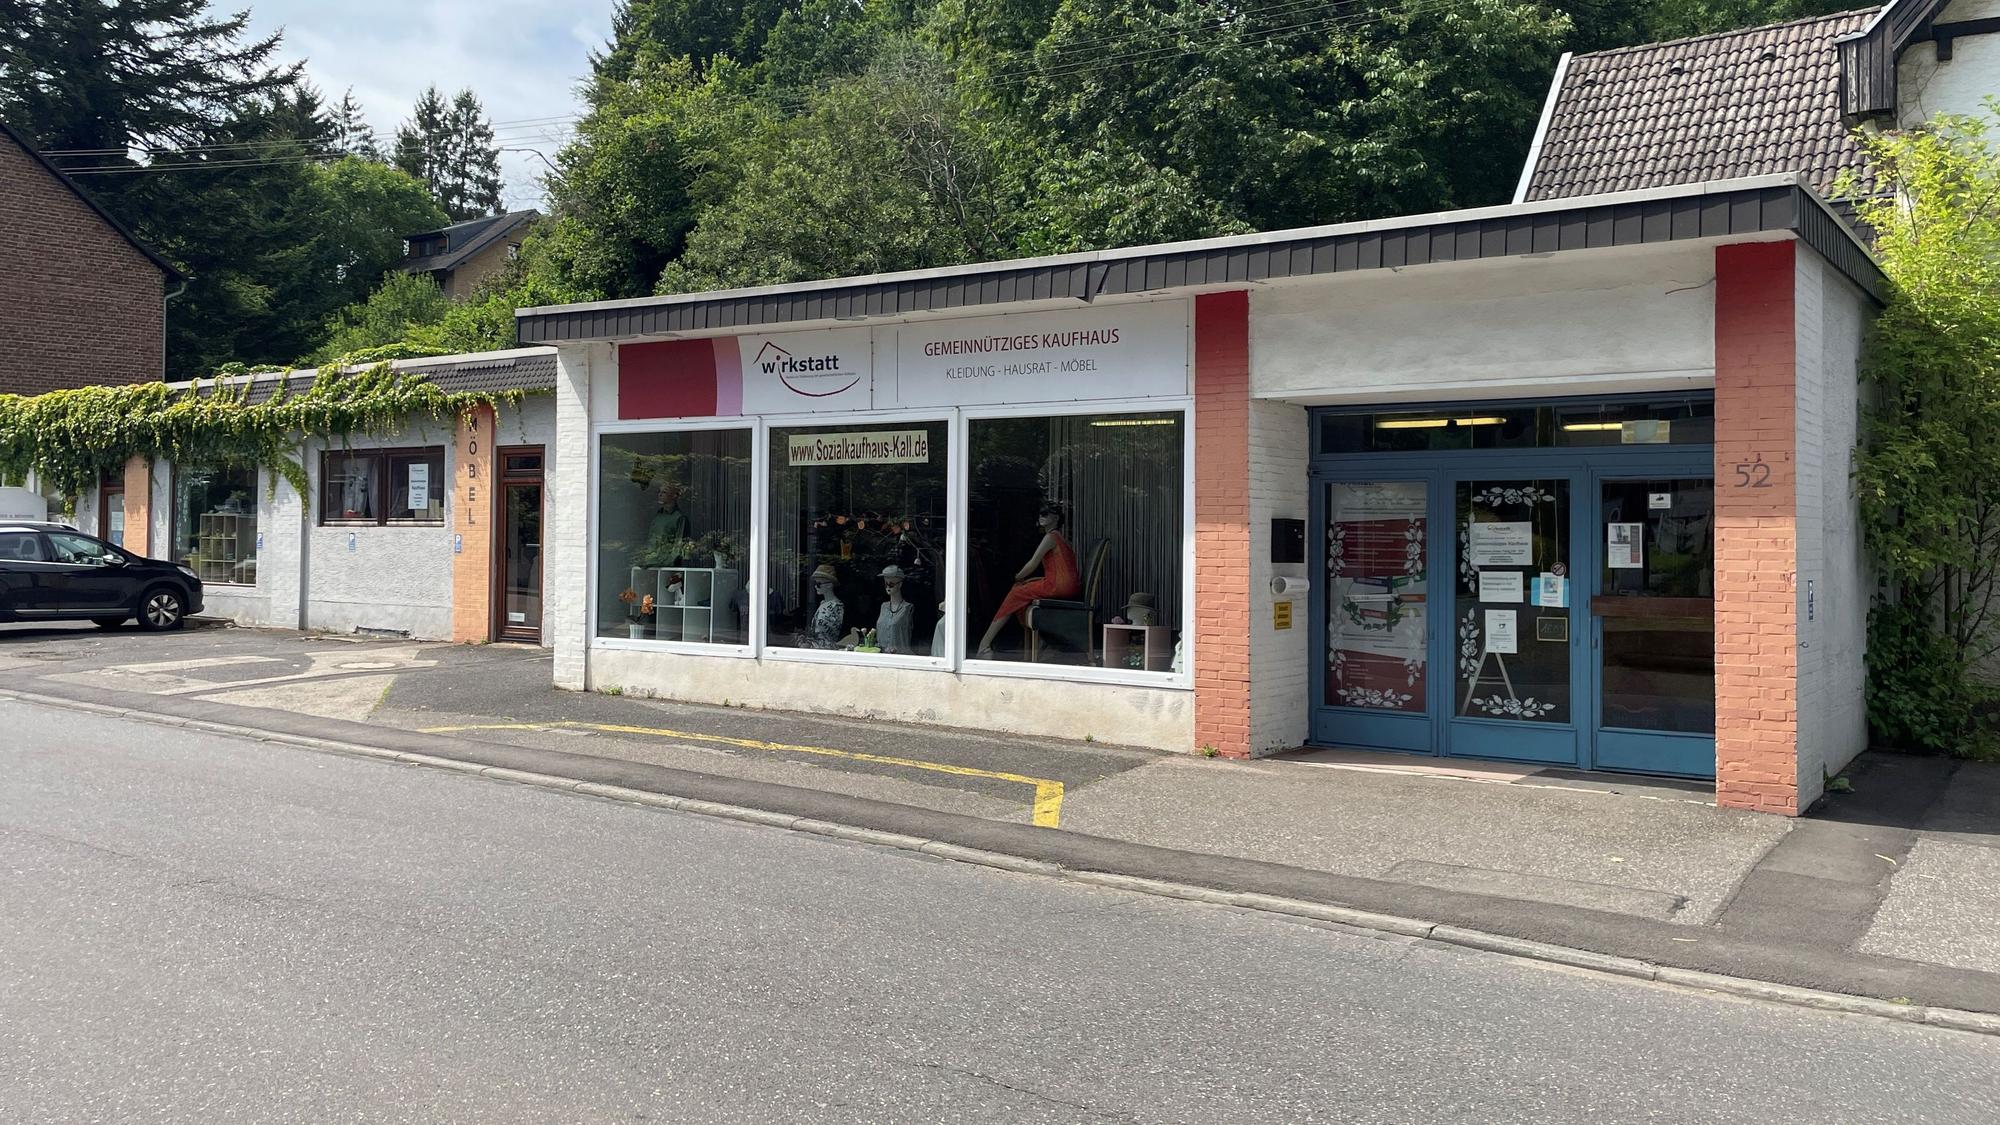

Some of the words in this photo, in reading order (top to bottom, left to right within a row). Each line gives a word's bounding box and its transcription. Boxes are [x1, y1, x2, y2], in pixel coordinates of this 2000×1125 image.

[925, 334, 1039, 357] GEMEINNÜTZIGES
[1042, 328, 1120, 349] KAUFHAUS
[761, 354, 840, 375] wirkstatt
[946, 365, 996, 379] KLEIDUNG
[1003, 361, 1052, 376] HAUSRAT
[1060, 357, 1098, 373] MÖBEL
[790, 434, 927, 462] www.Sozialkaufhaus-Kall.de
[1734, 463, 1773, 488] 52
